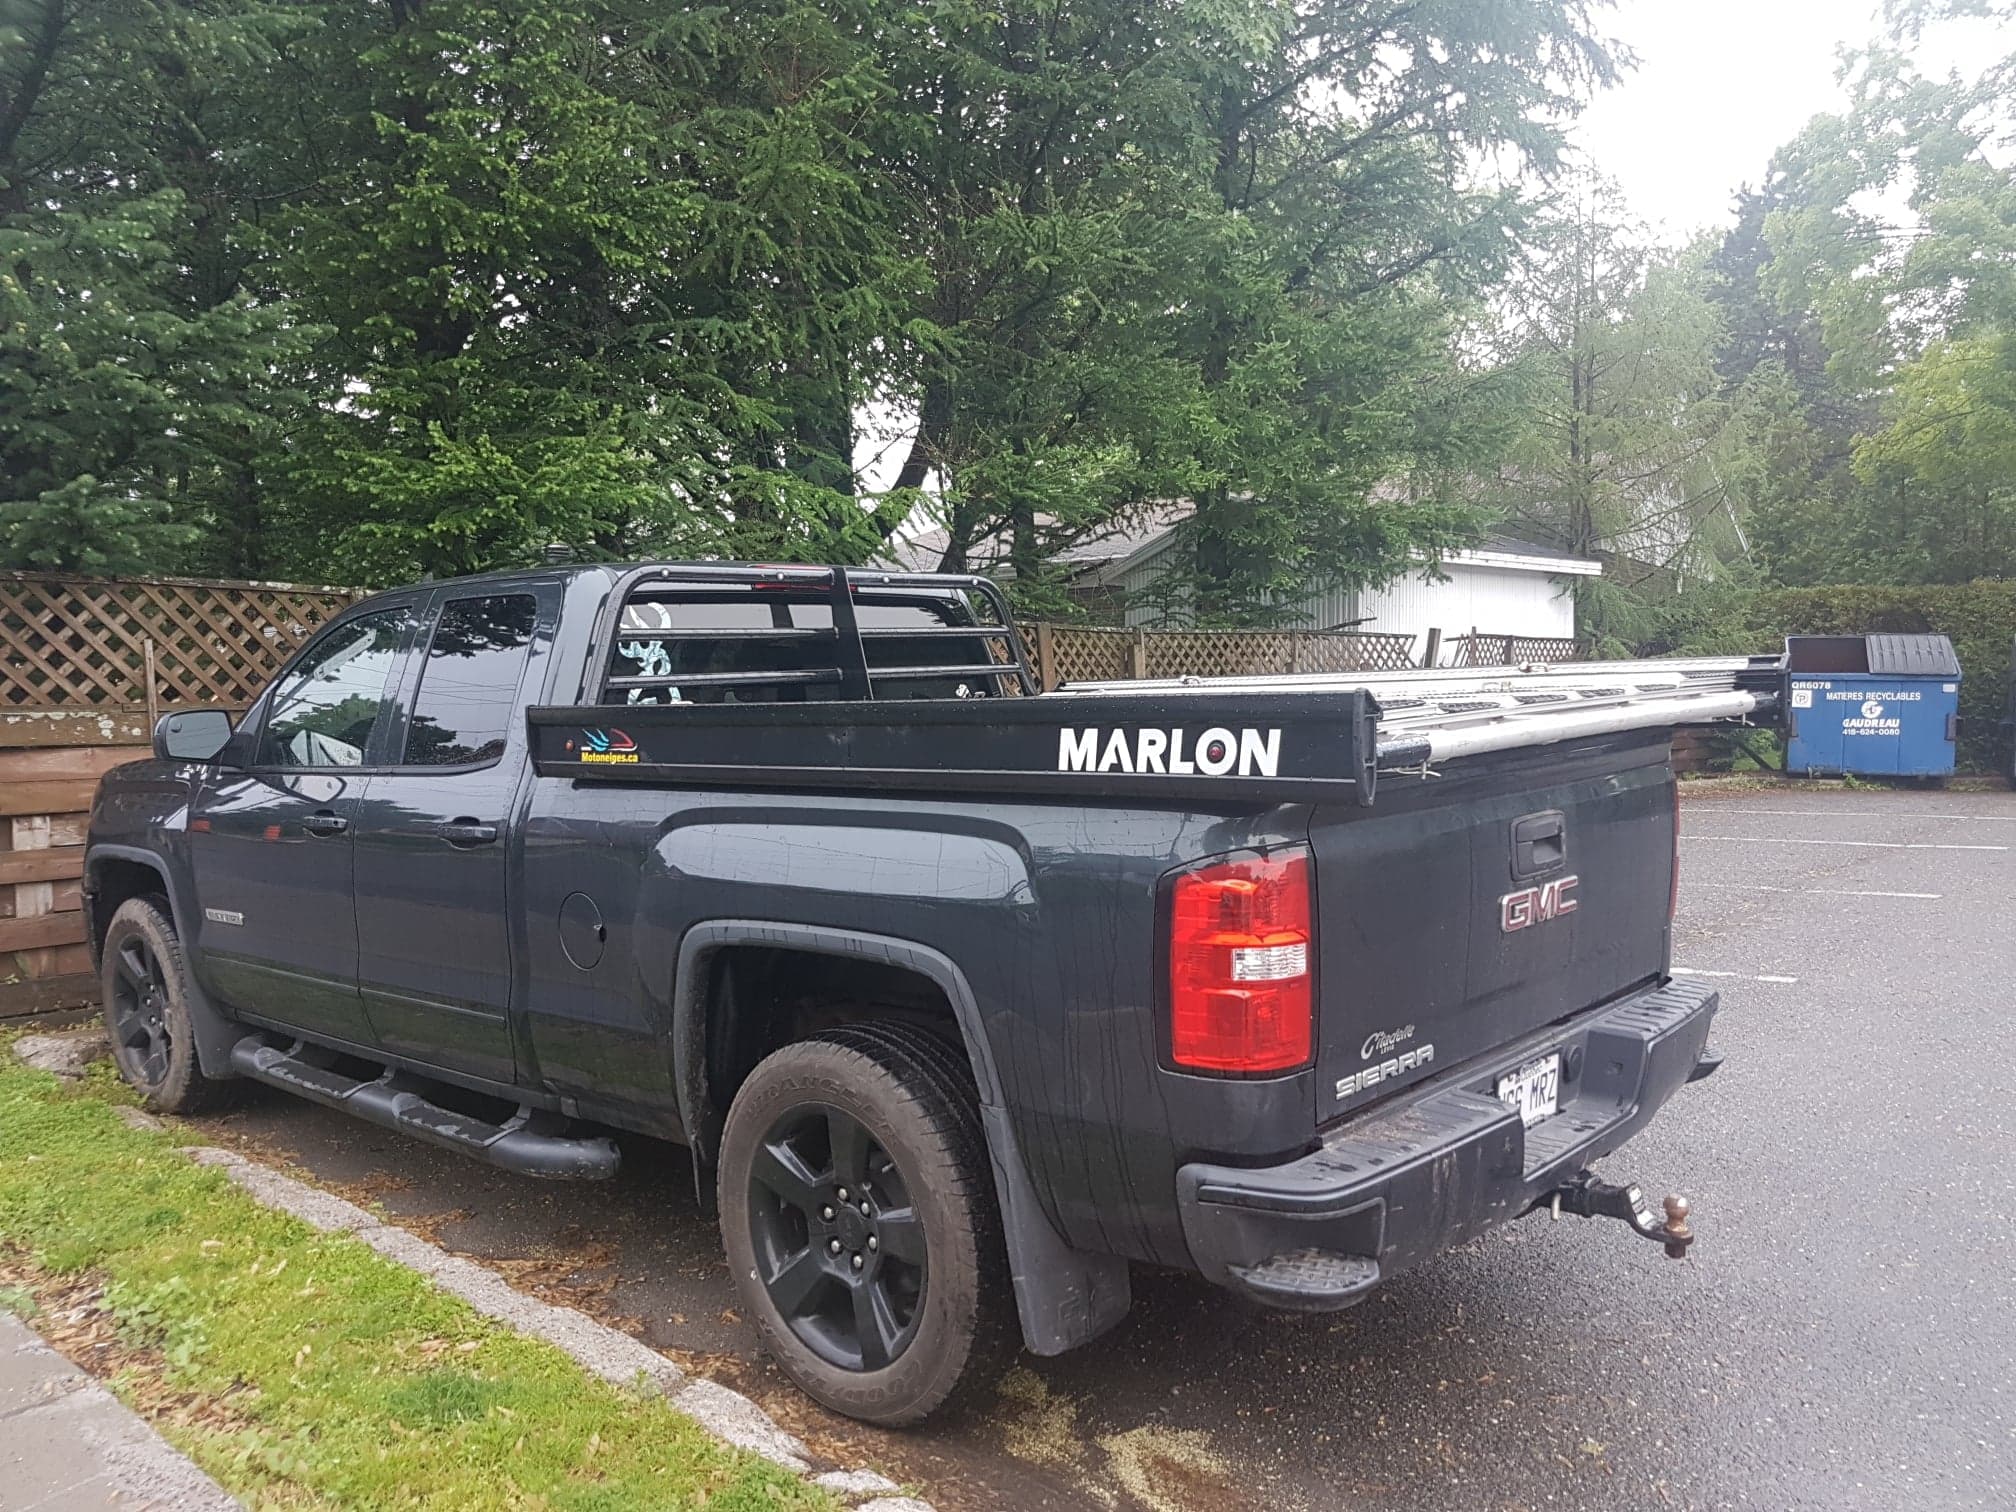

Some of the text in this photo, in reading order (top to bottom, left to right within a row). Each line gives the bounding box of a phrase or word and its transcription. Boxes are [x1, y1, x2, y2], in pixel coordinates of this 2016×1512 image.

[1865, 692, 1921, 700] RECYCLABLES
[1841, 718, 1900, 728] GAUDREAU
[581, 751, 639, 764] Motoneiges.ca
[1058, 727, 1282, 777] MARLON
[1502, 874, 1578, 932] GMC
[1336, 1044, 1434, 1100] SIERRA
[1530, 1068, 1557, 1112] MRZ
